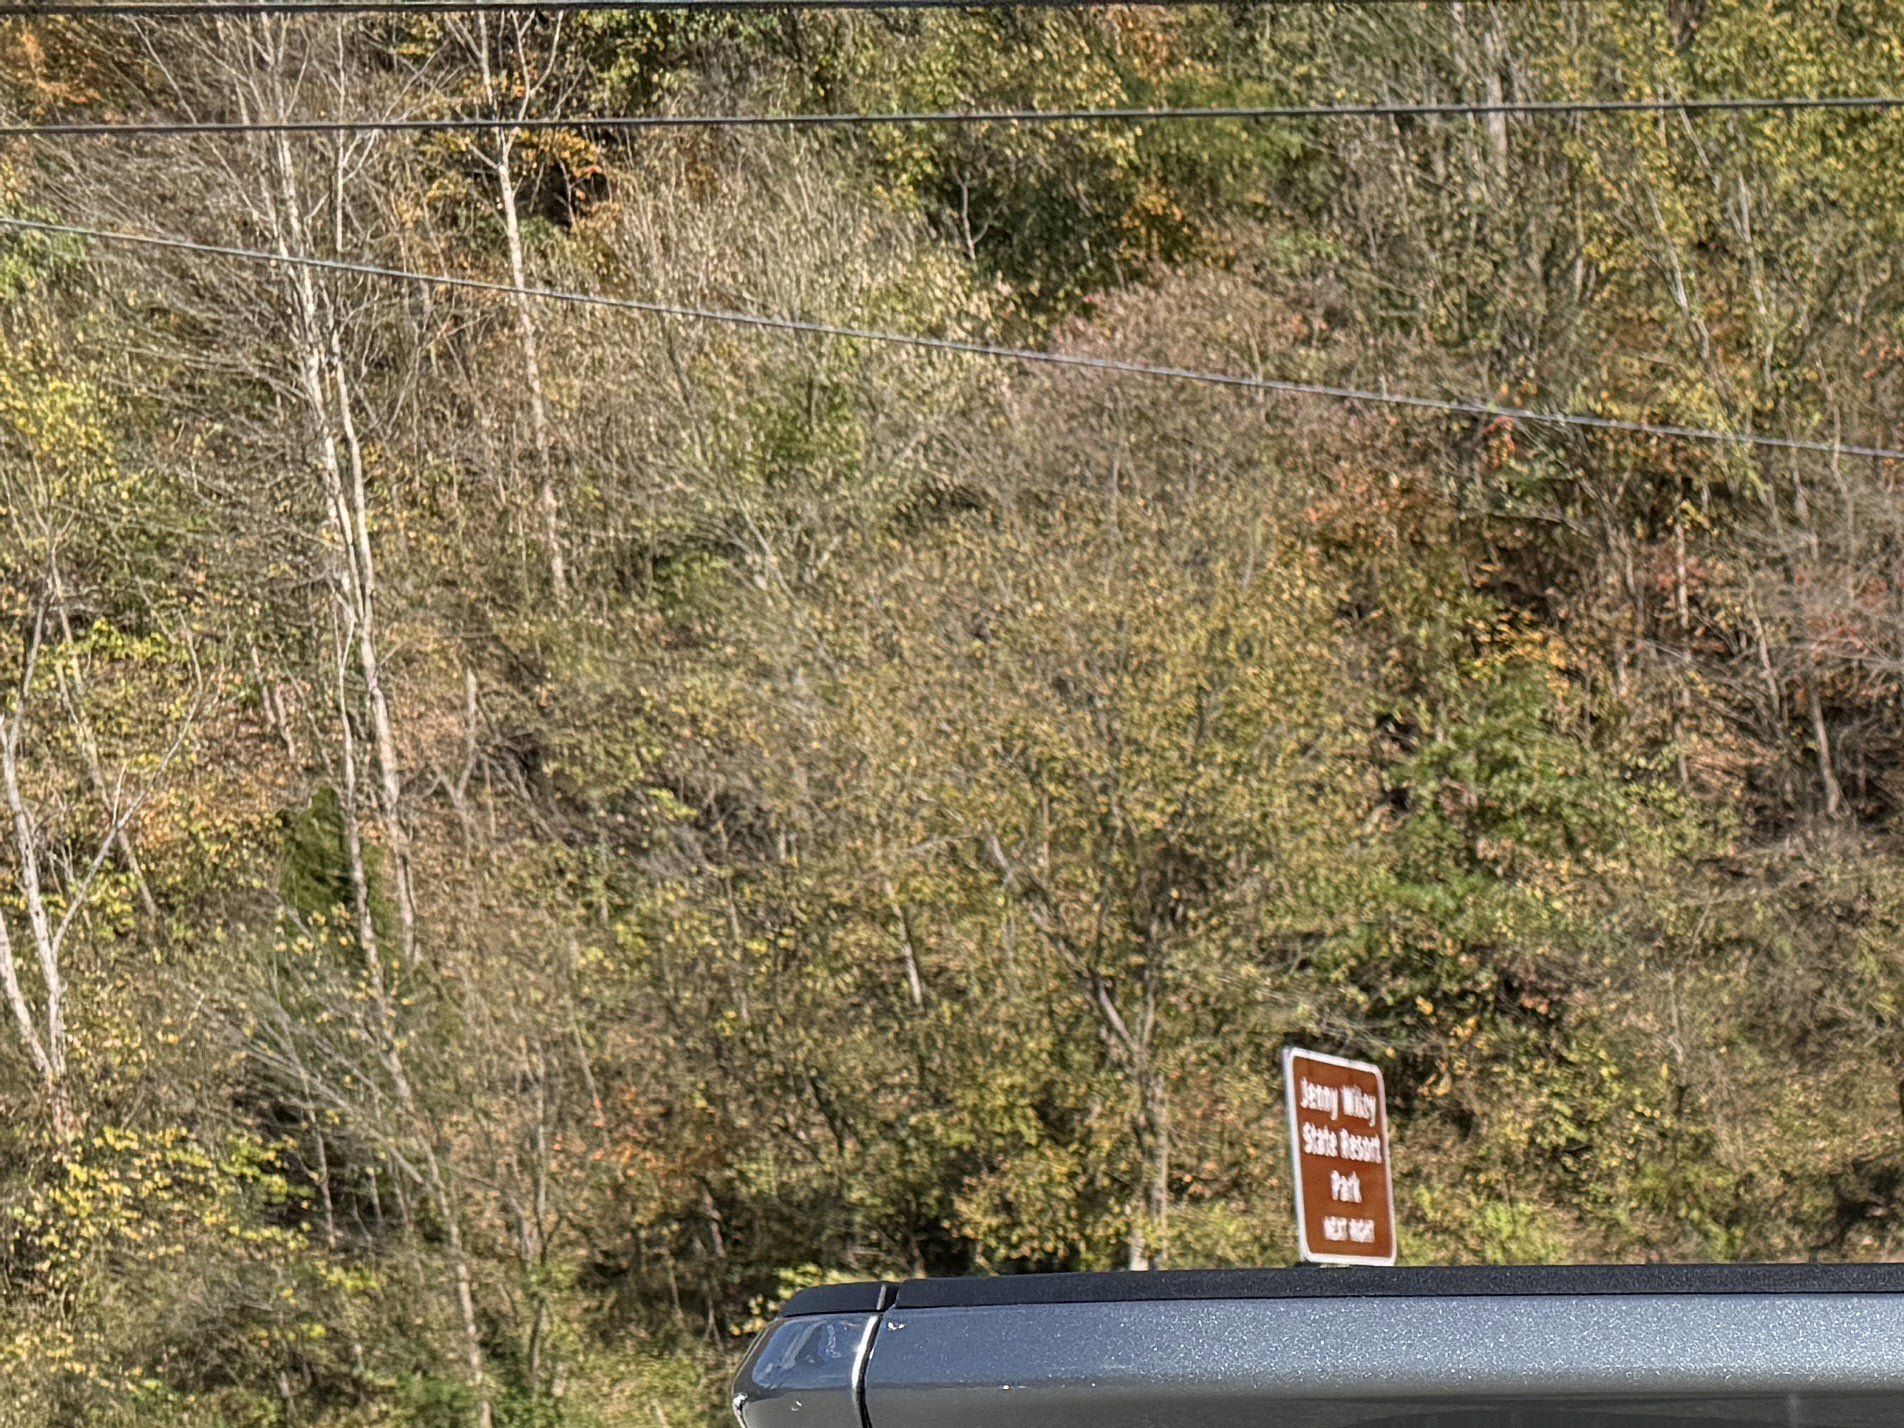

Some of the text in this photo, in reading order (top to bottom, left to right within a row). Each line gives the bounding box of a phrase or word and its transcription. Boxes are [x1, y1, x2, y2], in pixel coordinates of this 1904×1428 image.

[1302, 1121, 1382, 1164] State Resort
[1330, 1170, 1363, 1204] Park
